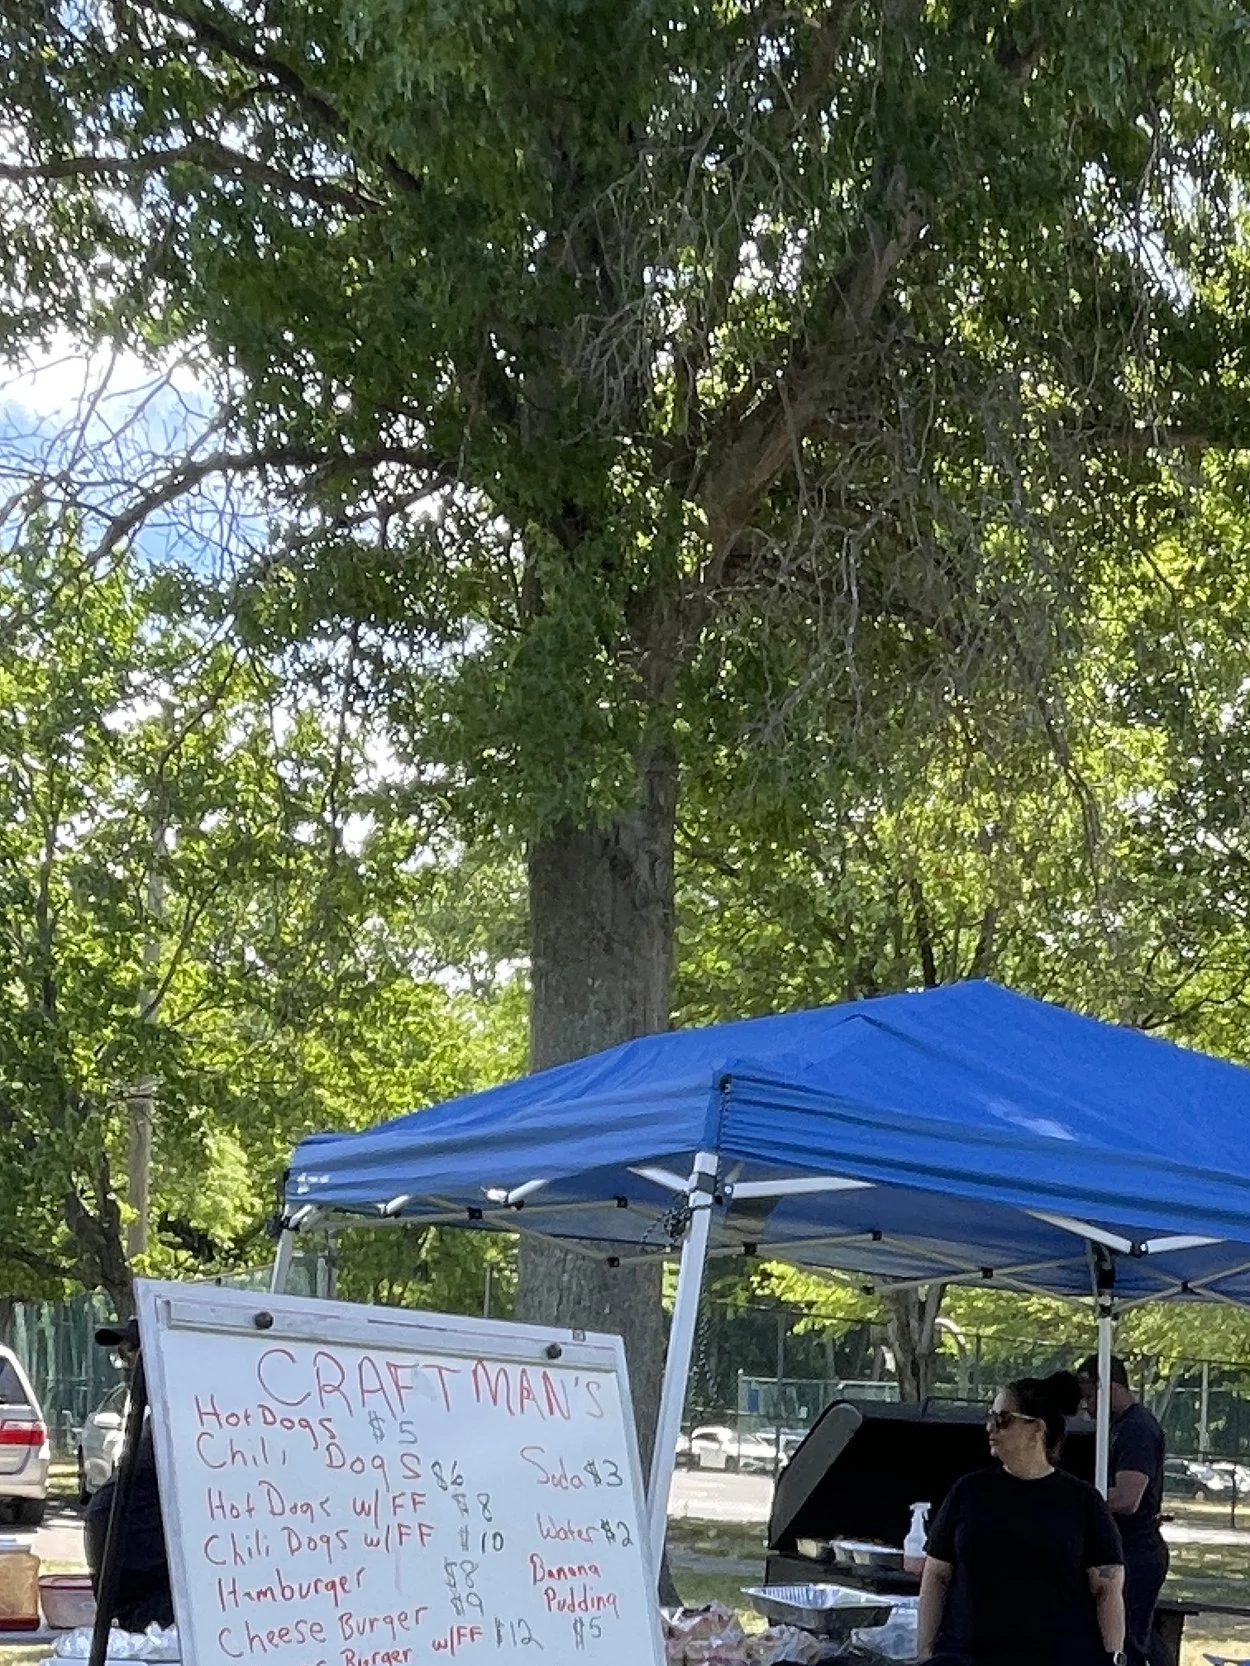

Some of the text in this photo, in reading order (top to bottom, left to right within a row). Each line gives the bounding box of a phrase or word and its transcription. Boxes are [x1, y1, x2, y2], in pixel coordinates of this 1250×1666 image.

[257, 1348, 604, 1421] CRAFTMAN'S
[196, 1431, 287, 1470] Chili
[325, 1441, 422, 1493] Dogs
[519, 1445, 586, 1491] Soda
[207, 1487, 255, 1521] Hot
[257, 1479, 332, 1524] Dogs
[203, 1527, 270, 1566] Chili
[280, 1525, 350, 1565] Dogs
[536, 1512, 600, 1545] Water
[216, 1566, 367, 1613] Hamburger
[529, 1552, 602, 1586] Banana
[543, 1584, 621, 1620] Pudding
[217, 1618, 327, 1659] Cheese
[337, 1605, 429, 1642] Burger
